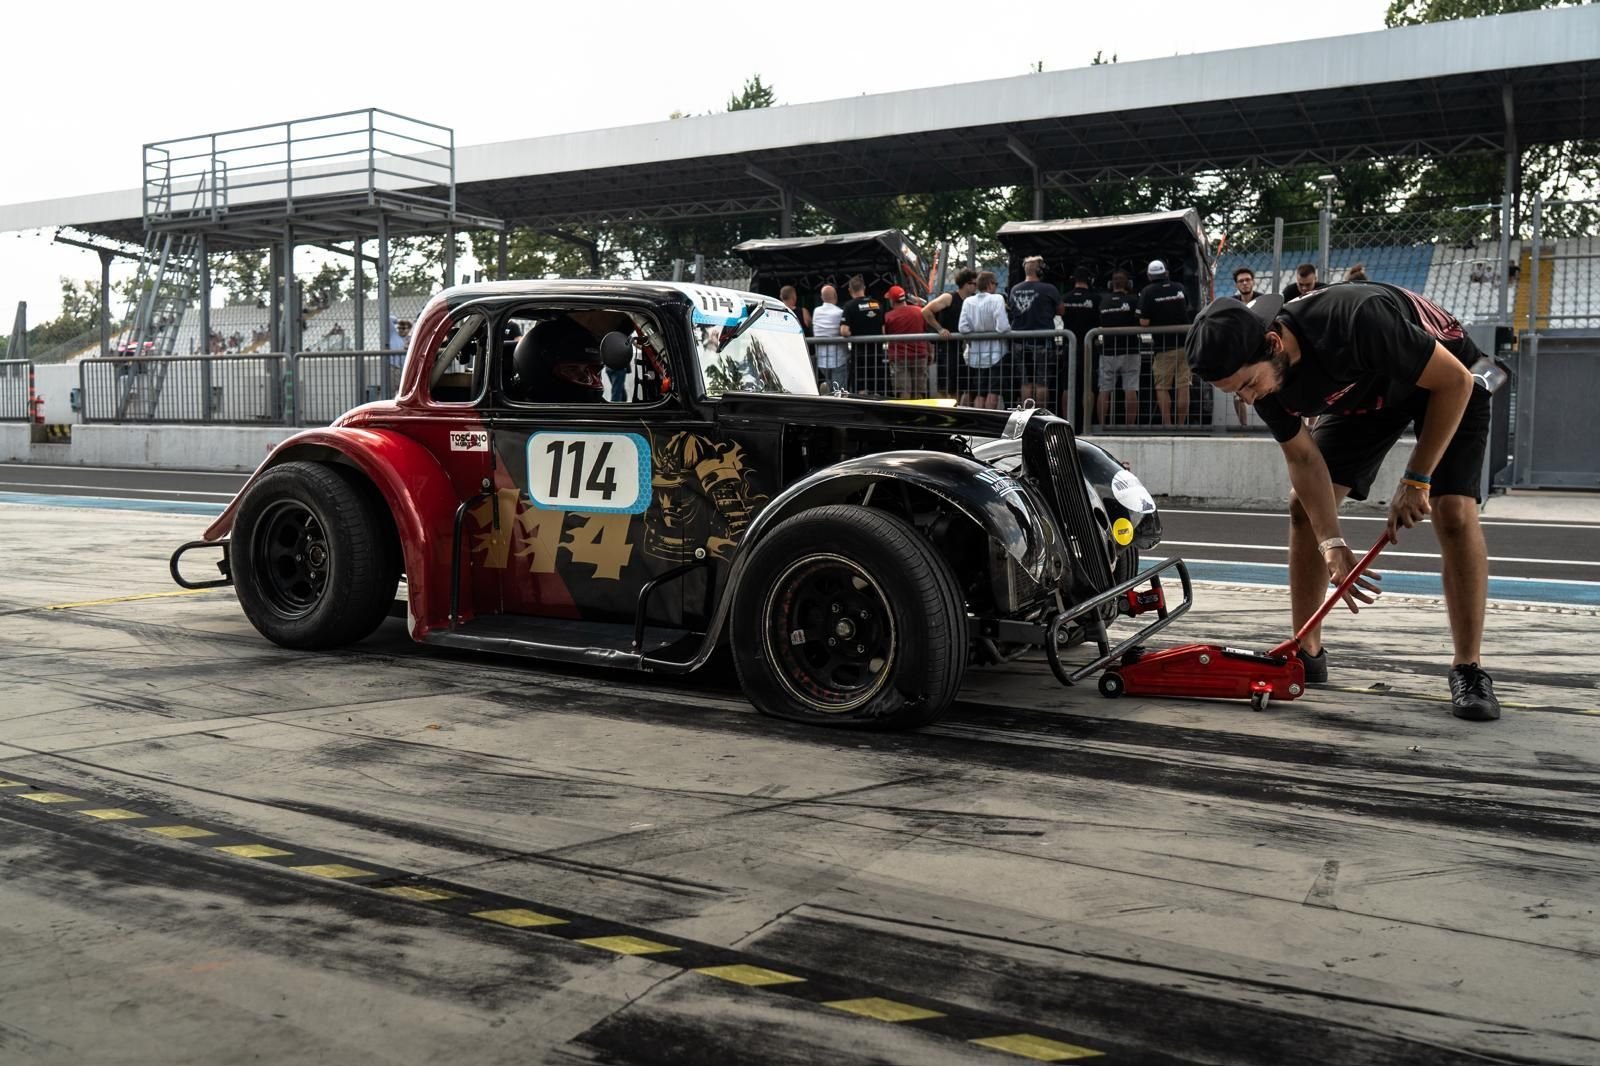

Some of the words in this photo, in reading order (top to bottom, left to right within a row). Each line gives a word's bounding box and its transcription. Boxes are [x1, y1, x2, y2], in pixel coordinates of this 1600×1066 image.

[695, 290, 734, 313] 114
[451, 433, 487, 441] TOSCANO
[546, 440, 617, 501] 114
[468, 488, 634, 580] 114
